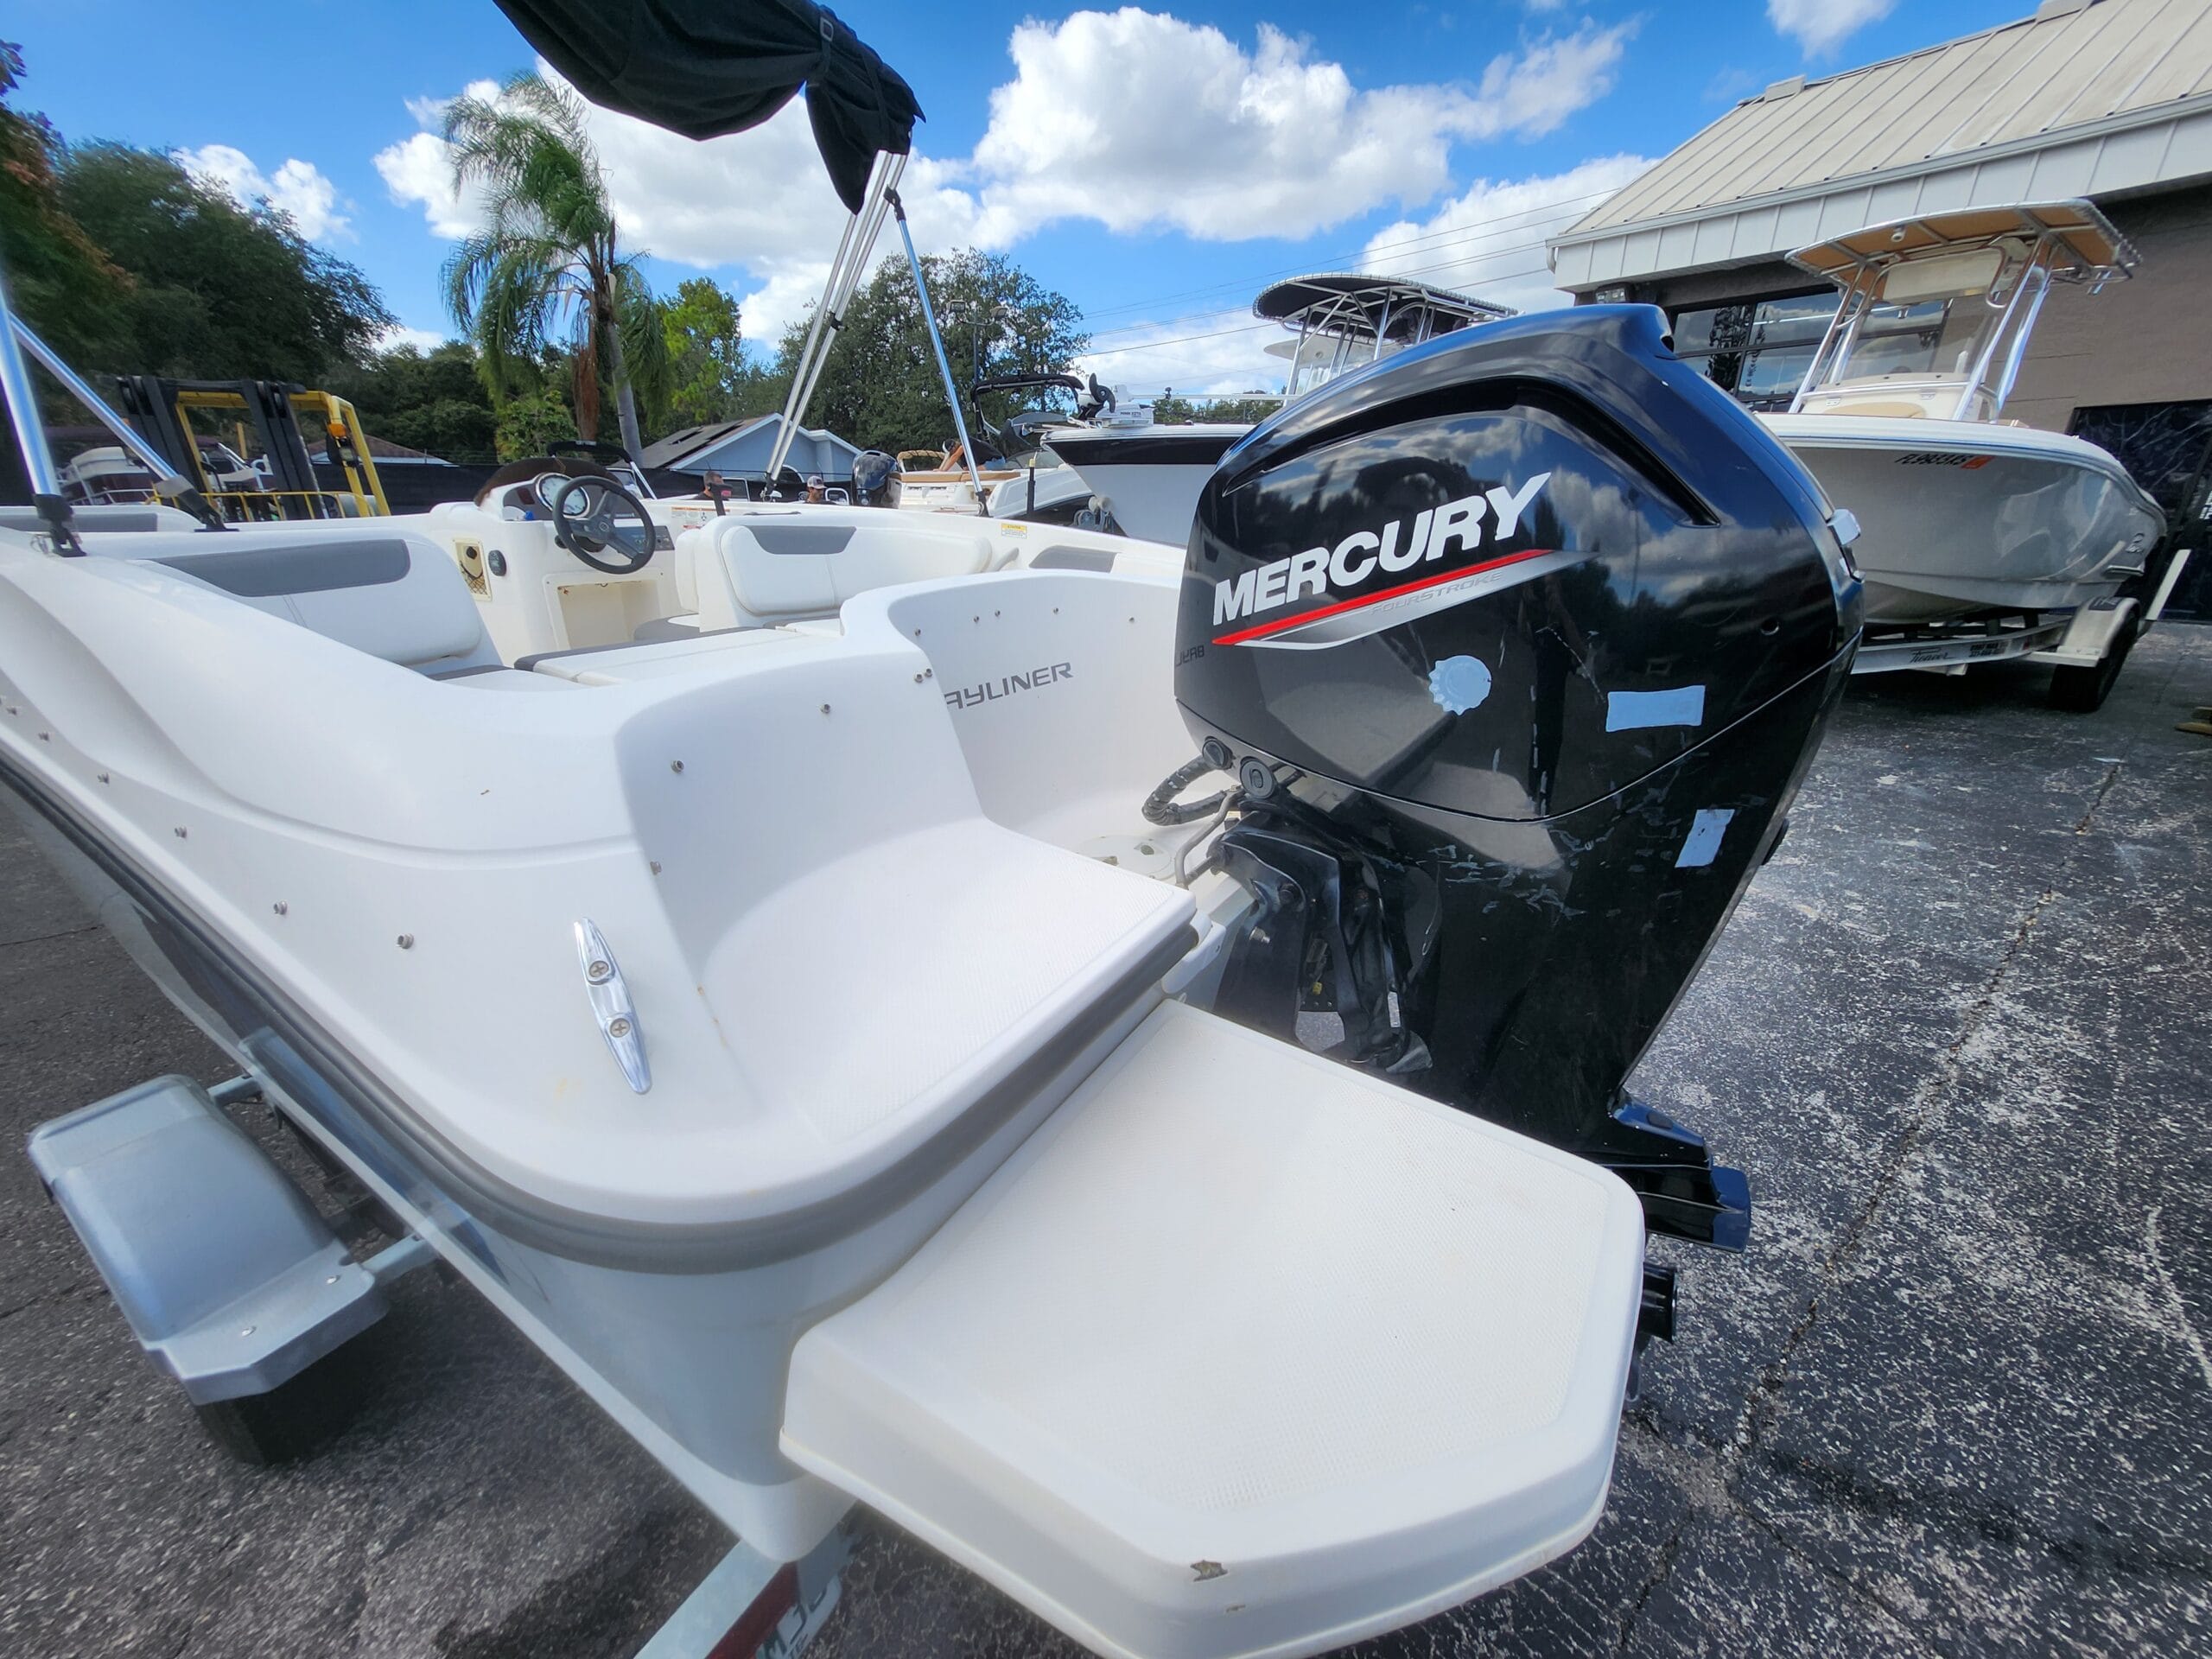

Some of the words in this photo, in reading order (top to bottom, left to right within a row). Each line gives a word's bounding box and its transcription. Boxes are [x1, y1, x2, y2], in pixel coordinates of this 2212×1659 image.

[1213, 472, 1551, 626] MERCURY
[1370, 571, 1503, 615] FOURSTROKE
[944, 662, 1074, 709] AYLINER
